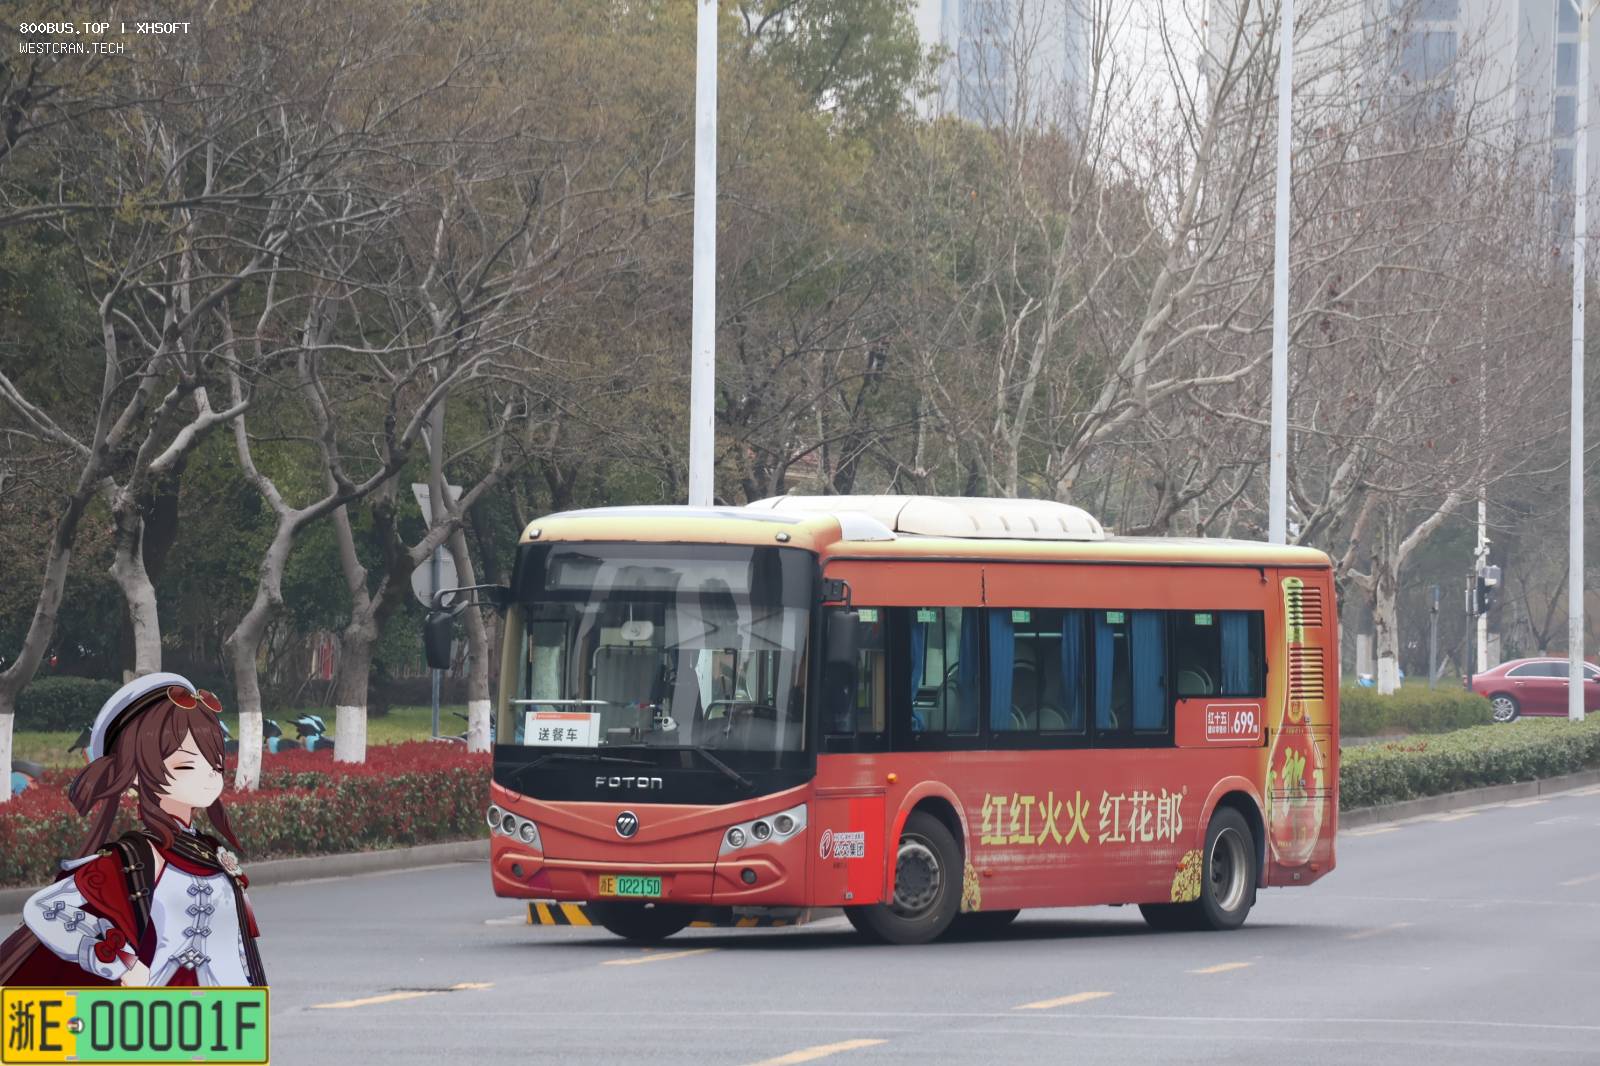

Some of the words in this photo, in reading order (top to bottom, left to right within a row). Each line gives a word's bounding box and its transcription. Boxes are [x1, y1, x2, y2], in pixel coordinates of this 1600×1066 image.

[1207, 711, 1227, 725] 红十五
[1230, 711, 1258, 734] 699
[538, 727, 578, 742] 送餐车
[595, 776, 663, 789] FOTON
[980, 790, 1090, 846] 红红火火
[1098, 787, 1184, 845] 红花郎
